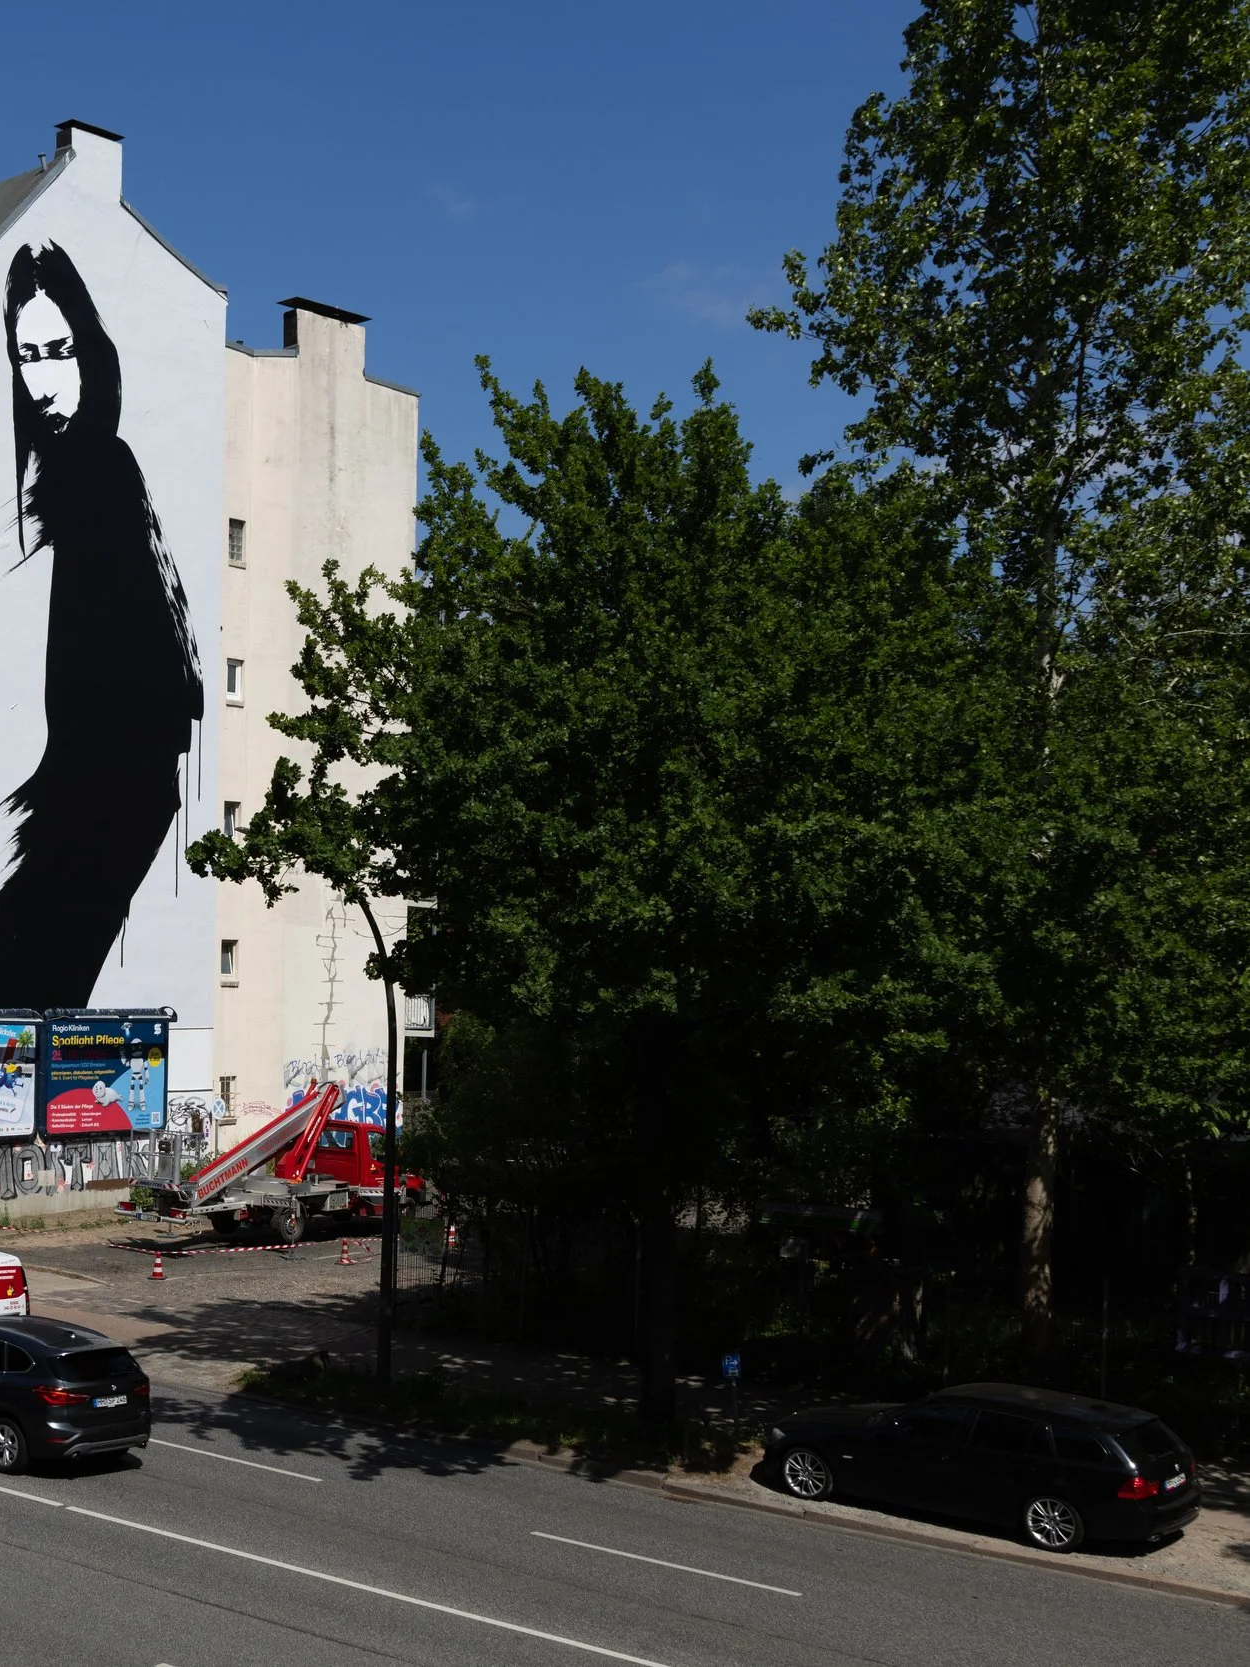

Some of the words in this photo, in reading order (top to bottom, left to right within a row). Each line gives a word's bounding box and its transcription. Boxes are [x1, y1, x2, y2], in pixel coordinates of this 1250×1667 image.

[52, 1035, 94, 1048] Spotlight
[96, 1035, 125, 1047] Pflege
[197, 1157, 249, 1200] BUCHTMANN
